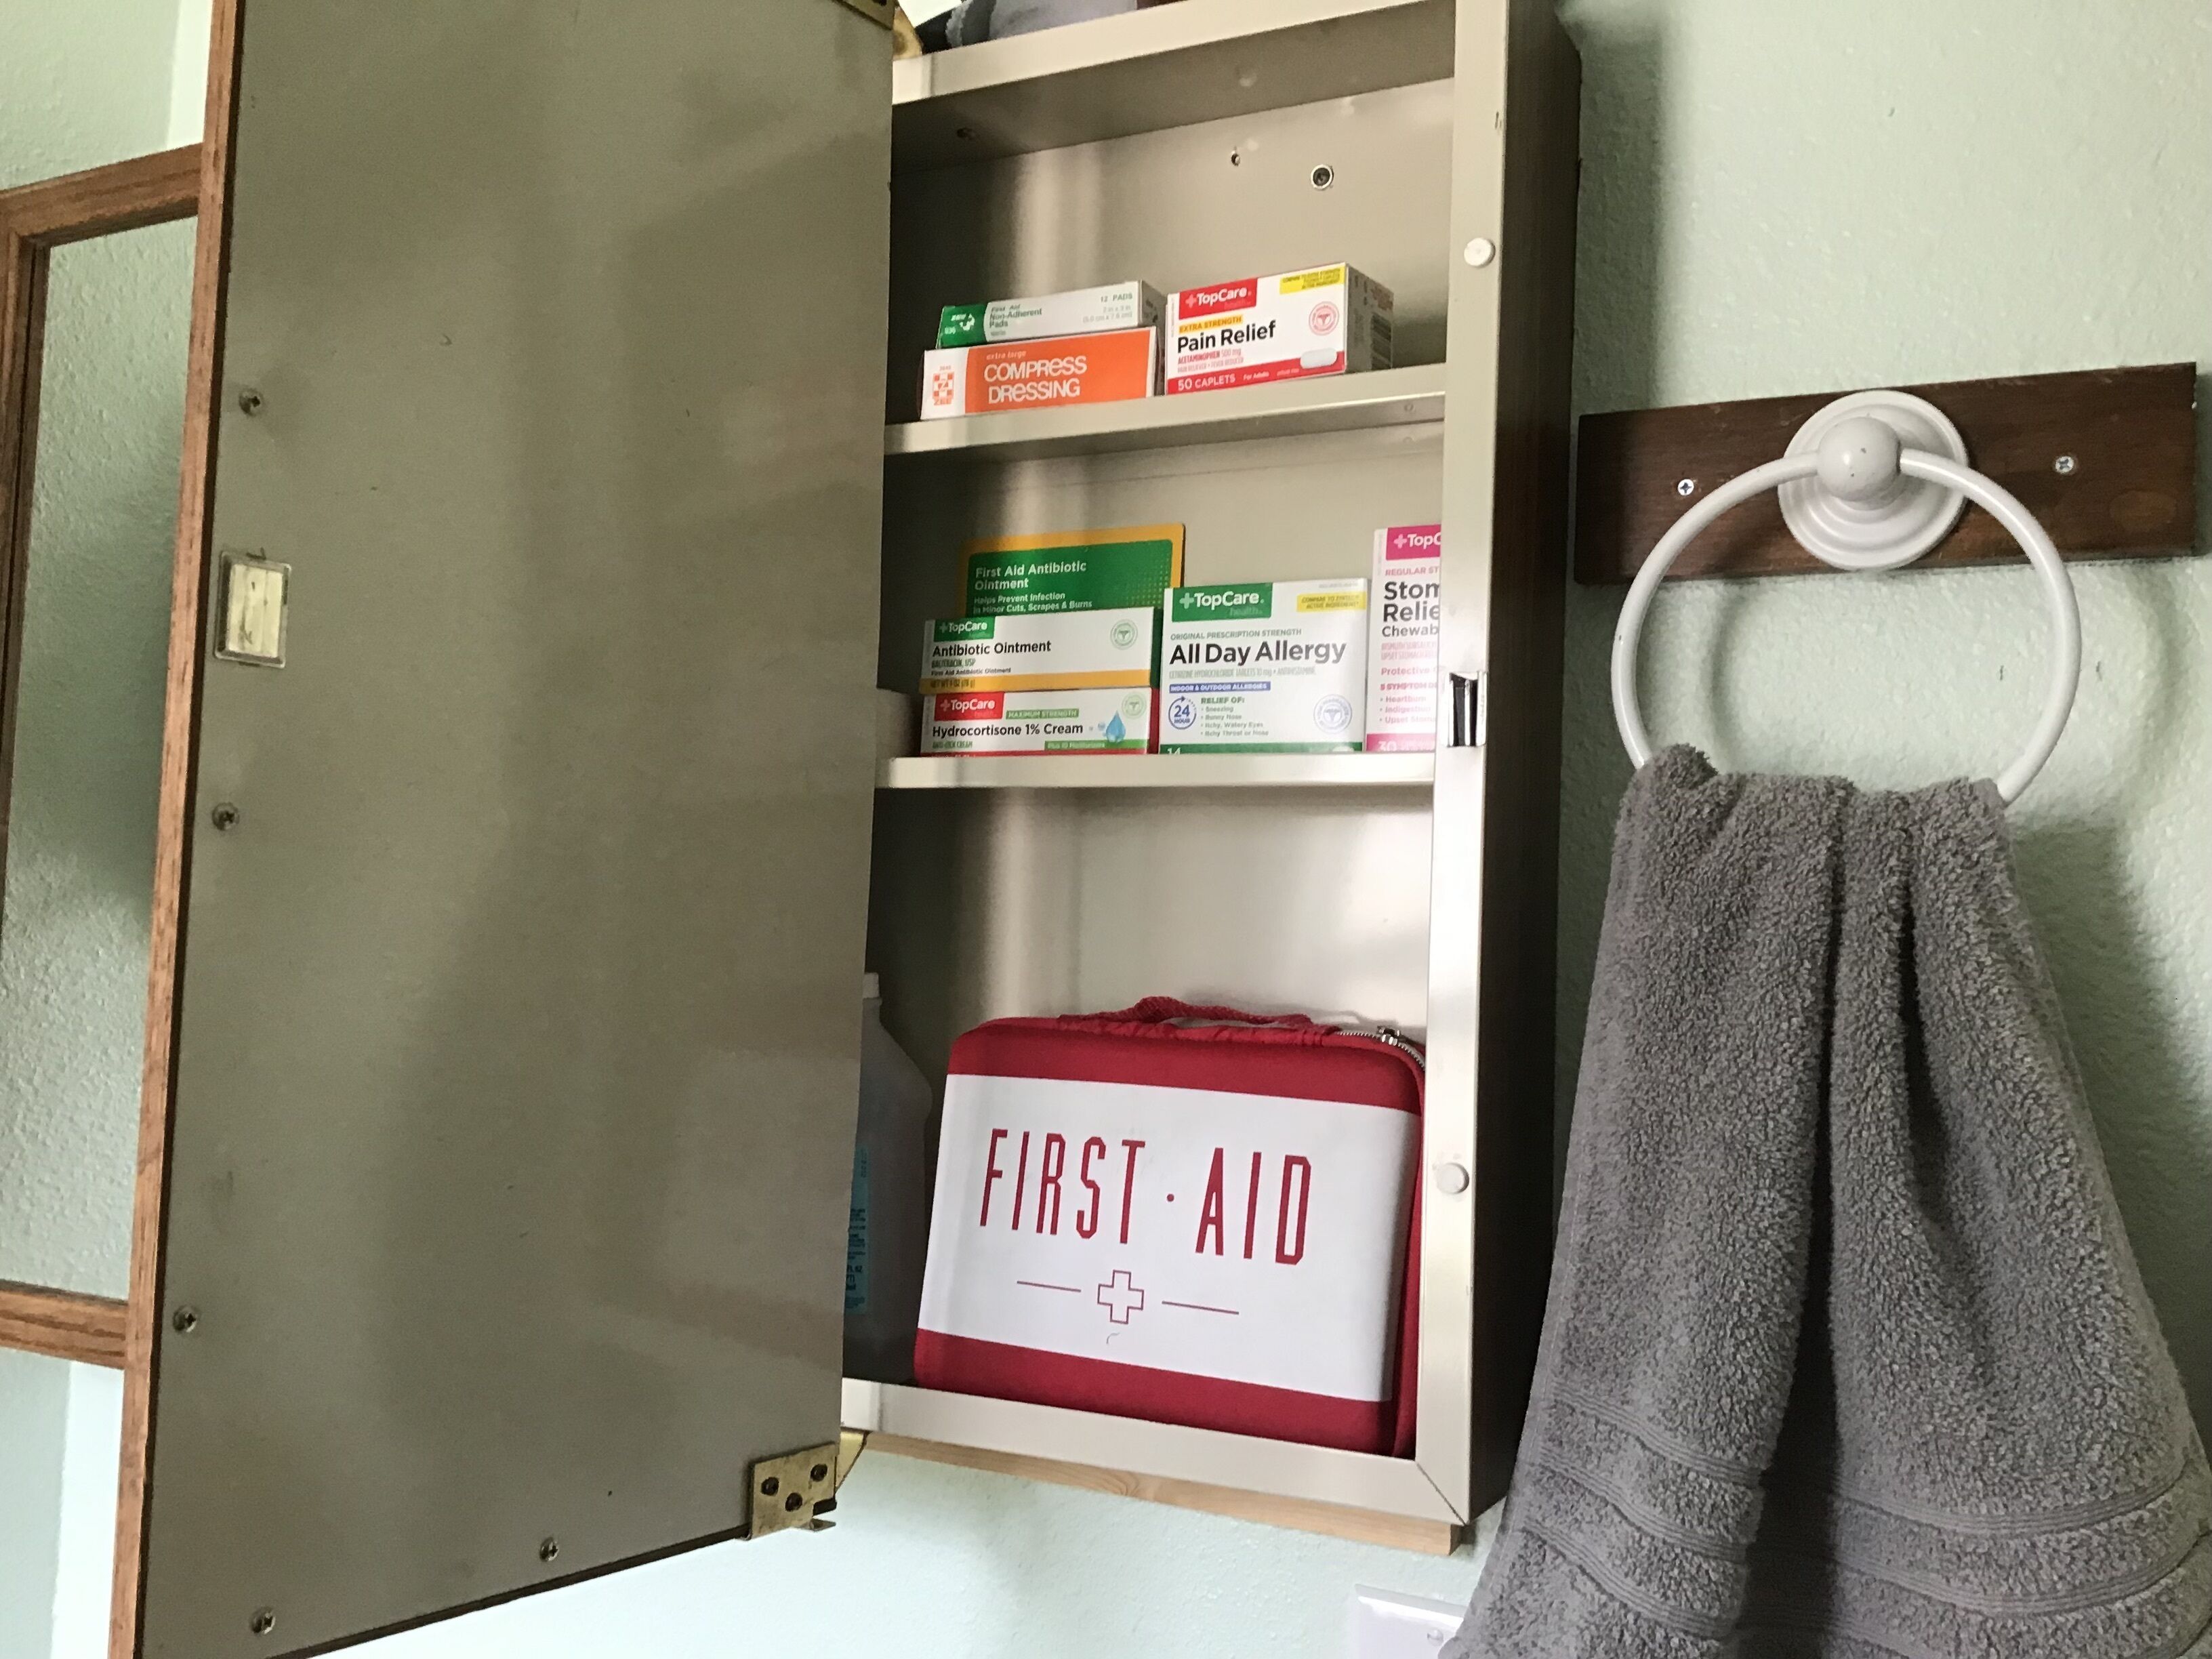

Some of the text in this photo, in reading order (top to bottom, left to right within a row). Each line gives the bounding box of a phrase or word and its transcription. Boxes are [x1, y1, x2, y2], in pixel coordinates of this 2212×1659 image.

[1113, 293, 1132, 301] PADS
[1197, 287, 1248, 306] TopCare
[990, 308, 1042, 320] Non-Adherent
[989, 320, 1008, 328] Pads
[1179, 315, 1242, 333] EXTRA STRENGTH
[1178, 319, 1276, 353] Pain Relief
[986, 350, 1027, 361] extra large
[1178, 373, 1236, 391] 50 CAPLETS
[1408, 532, 1441, 549] TopC
[976, 560, 1087, 578] First Aid Antibiotic
[1385, 567, 1426, 575] REGULAR
[975, 577, 1029, 590] Ointment
[975, 592, 1065, 605] Helps Prevent Infection
[1194, 590, 1260, 610] TopCare
[983, 605, 1004, 613] Minor
[1006, 603, 1026, 612] Cuts,
[1028, 601, 1059, 611] Scrapes
[1069, 600, 1092, 609] Burns
[1383, 600, 1439, 622] Relie
[949, 621, 987, 634] TopCare
[1207, 630, 1261, 638] PRESCRIPTION
[1262, 628, 1301, 636] STRENGTH
[1382, 623, 1438, 638] Chewab
[933, 640, 1052, 657] Antibiotic Ointment
[1170, 639, 1347, 666] All Day Allergy
[1381, 667, 1429, 676] Protective
[950, 699, 996, 713] TopCare
[1174, 705, 1190, 717] 24
[1008, 710, 1040, 718] MAXIMUM
[933, 722, 1083, 739] Hydrocortisone 1% Cream
[979, 1128, 1313, 1266] FIRST AID
